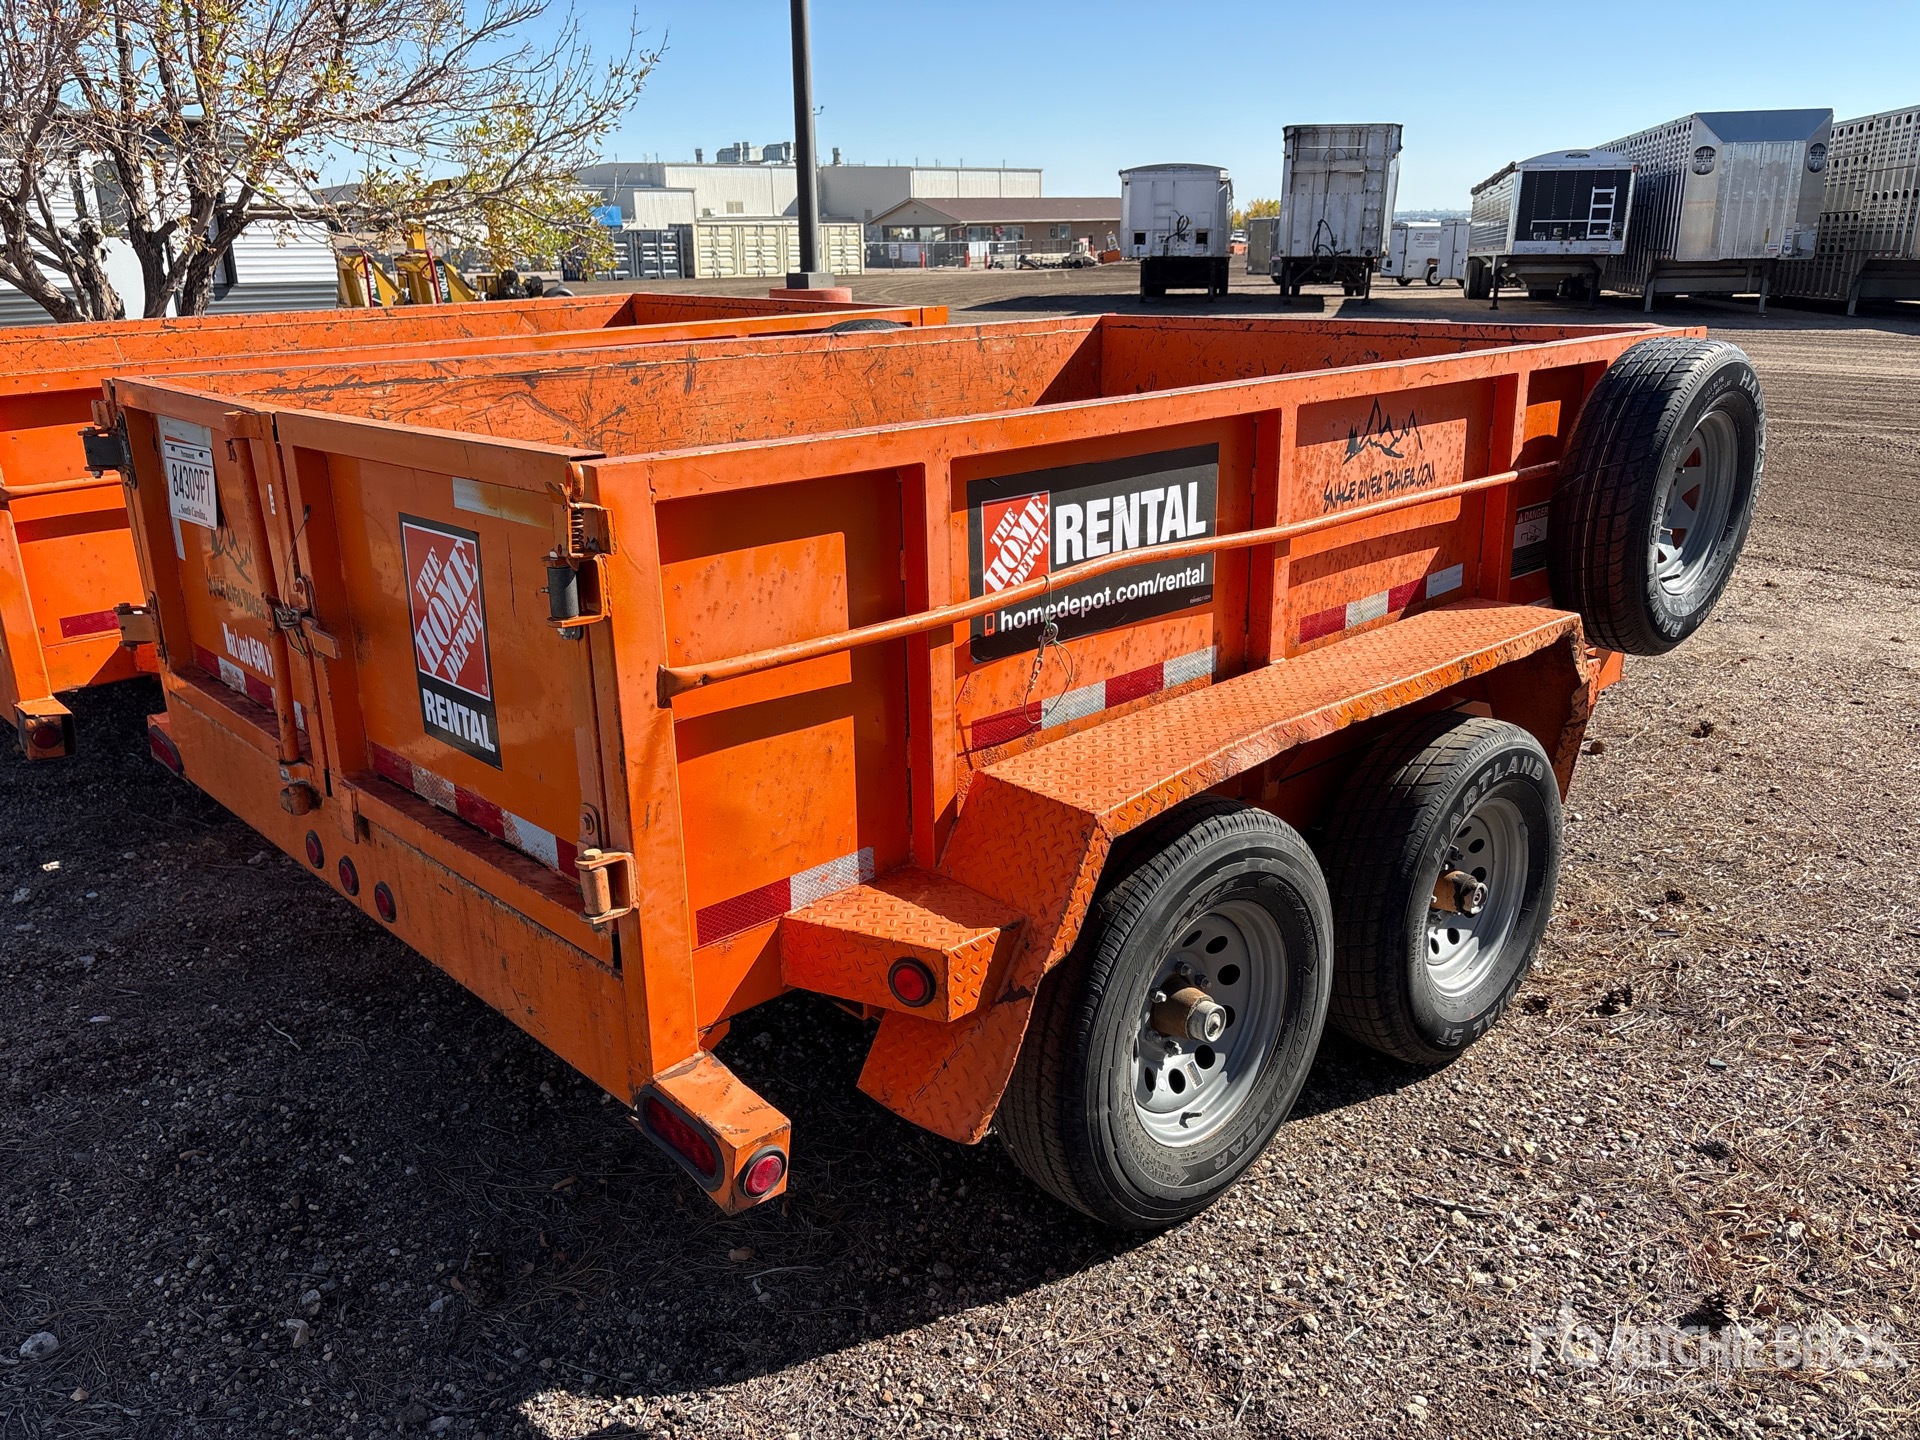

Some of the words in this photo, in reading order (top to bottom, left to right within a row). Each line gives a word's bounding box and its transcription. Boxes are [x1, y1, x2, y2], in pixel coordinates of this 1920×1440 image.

[171, 463, 211, 506] 84309PT
[180, 503, 192, 516] South
[191, 505, 206, 521] Carolina
[1357, 472, 1382, 501] RIVER
[1524, 506, 1549, 522] DANGER
[984, 494, 1049, 592] HOME
[989, 506, 1019, 549] THE
[1009, 522, 1050, 588] DEPOT
[1055, 481, 1207, 565] RENTAL
[415, 546, 443, 603] THE
[415, 537, 479, 676] HOME
[1000, 563, 1205, 633] homedepot.com/rental
[443, 599, 483, 684] DEPOT
[422, 687, 496, 753] RENTAL
[1432, 755, 1545, 867] HARTLAND
[1436, 1026, 1464, 1047] ST
[1214, 1007, 1312, 1171] GOODYEAR
